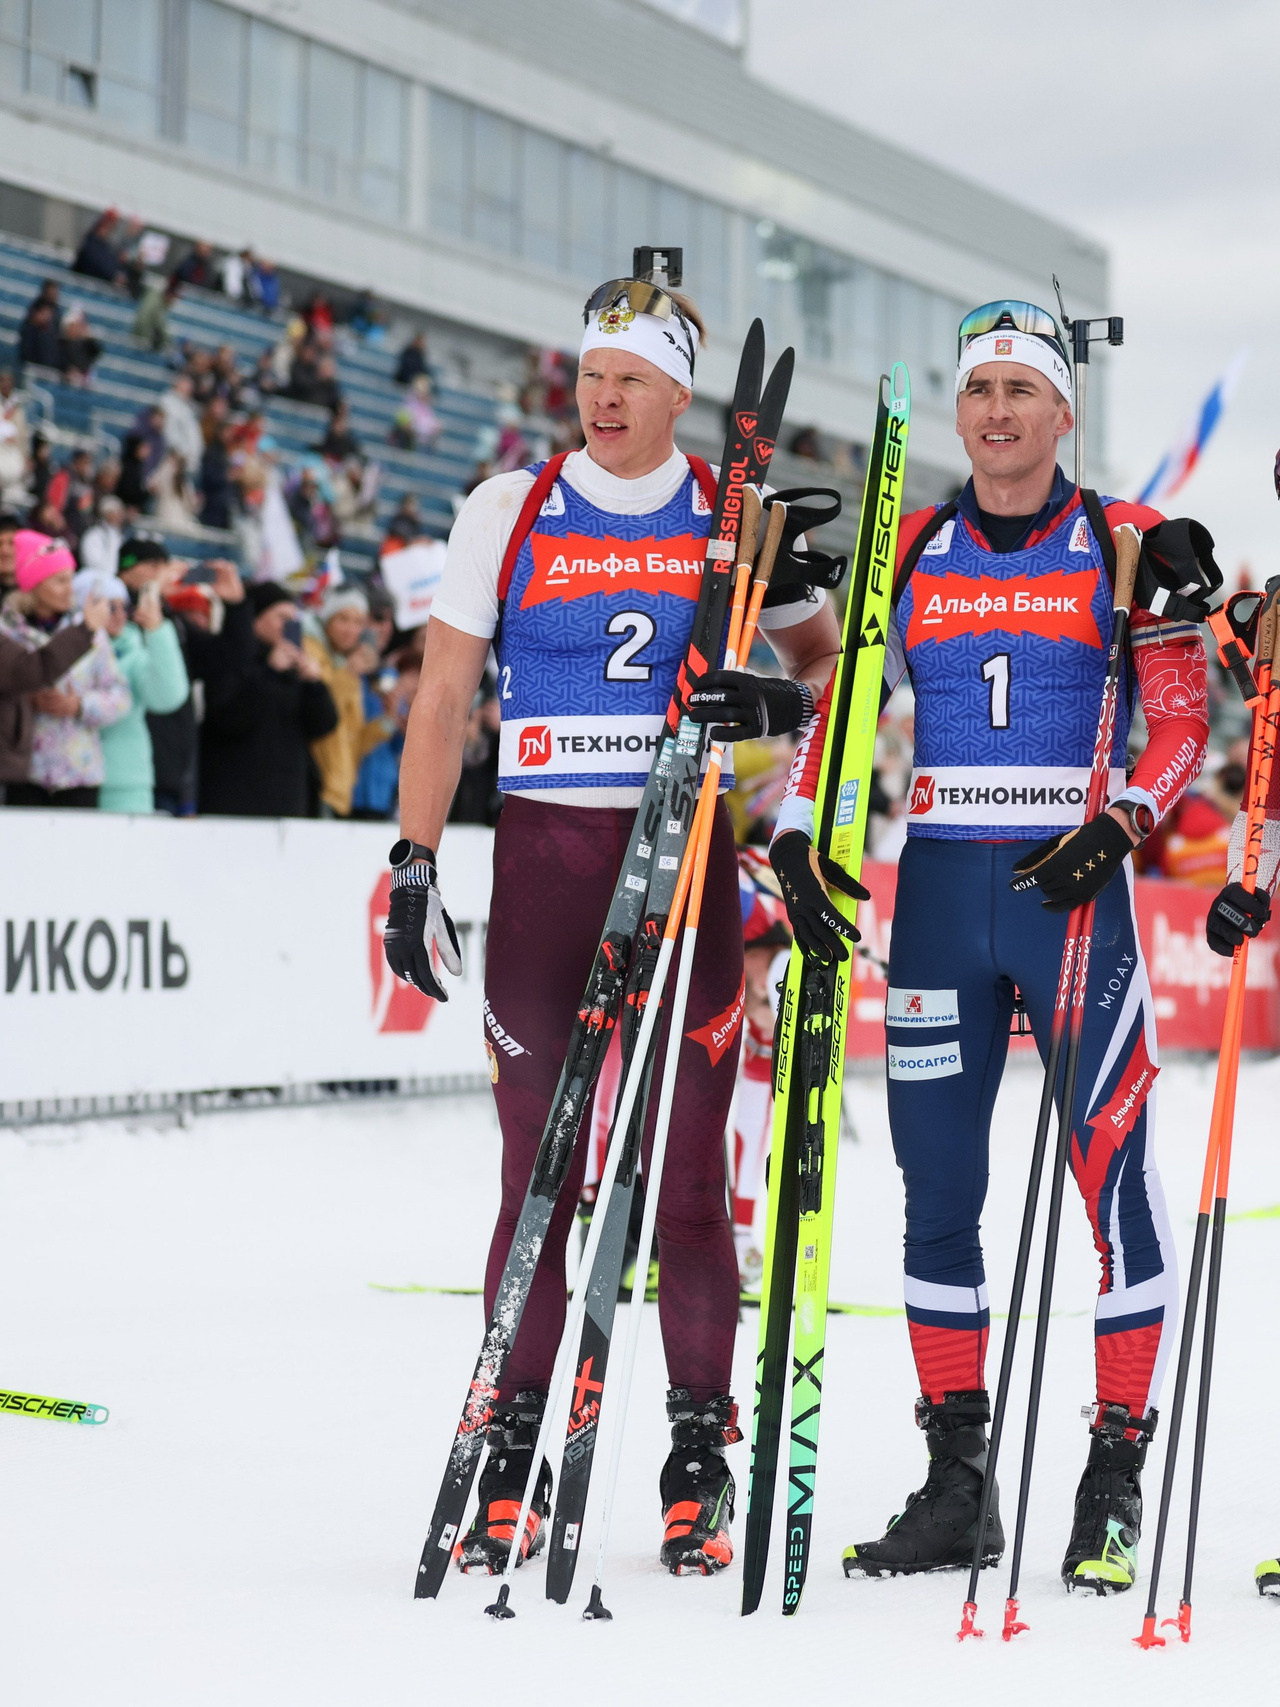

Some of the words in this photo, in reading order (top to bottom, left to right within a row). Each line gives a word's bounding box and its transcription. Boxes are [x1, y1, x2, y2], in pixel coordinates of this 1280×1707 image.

[713, 456, 749, 574] ROSSIGNOL
[871, 416, 905, 597] FISCHER
[546, 552, 641, 585] Альфа
[645, 553, 705, 575] Бан
[922, 592, 1008, 625] Альфа
[1013, 591, 1080, 614] Банк
[603, 608, 658, 683] 2
[502, 665, 512, 700] 2
[980, 652, 1012, 730] 1
[938, 786, 1110, 805] ТЕХНОНИКО
[1012, 875, 1039, 893] MOAX
[5, 918, 190, 994] ИКОЛЬ
[820, 910, 850, 938] MOAX
[1057, 937, 1076, 1012] MOAX
[1077, 935, 1092, 1009] MOAX
[1097, 952, 1135, 1010] MOAX
[712, 1005, 742, 1049] Альфа
[777, 987, 795, 1095] FISCHER
[830, 974, 846, 1086] FISCHER
[897, 1053, 958, 1070] ФОСАГРО
[1110, 1092, 1136, 1129] Альфа
[1130, 1067, 1150, 1095] Банк
[563, 1430, 597, 1466] 193
[787, 1346, 825, 1516] MAX
[785, 1525, 805, 1606] SPEED
